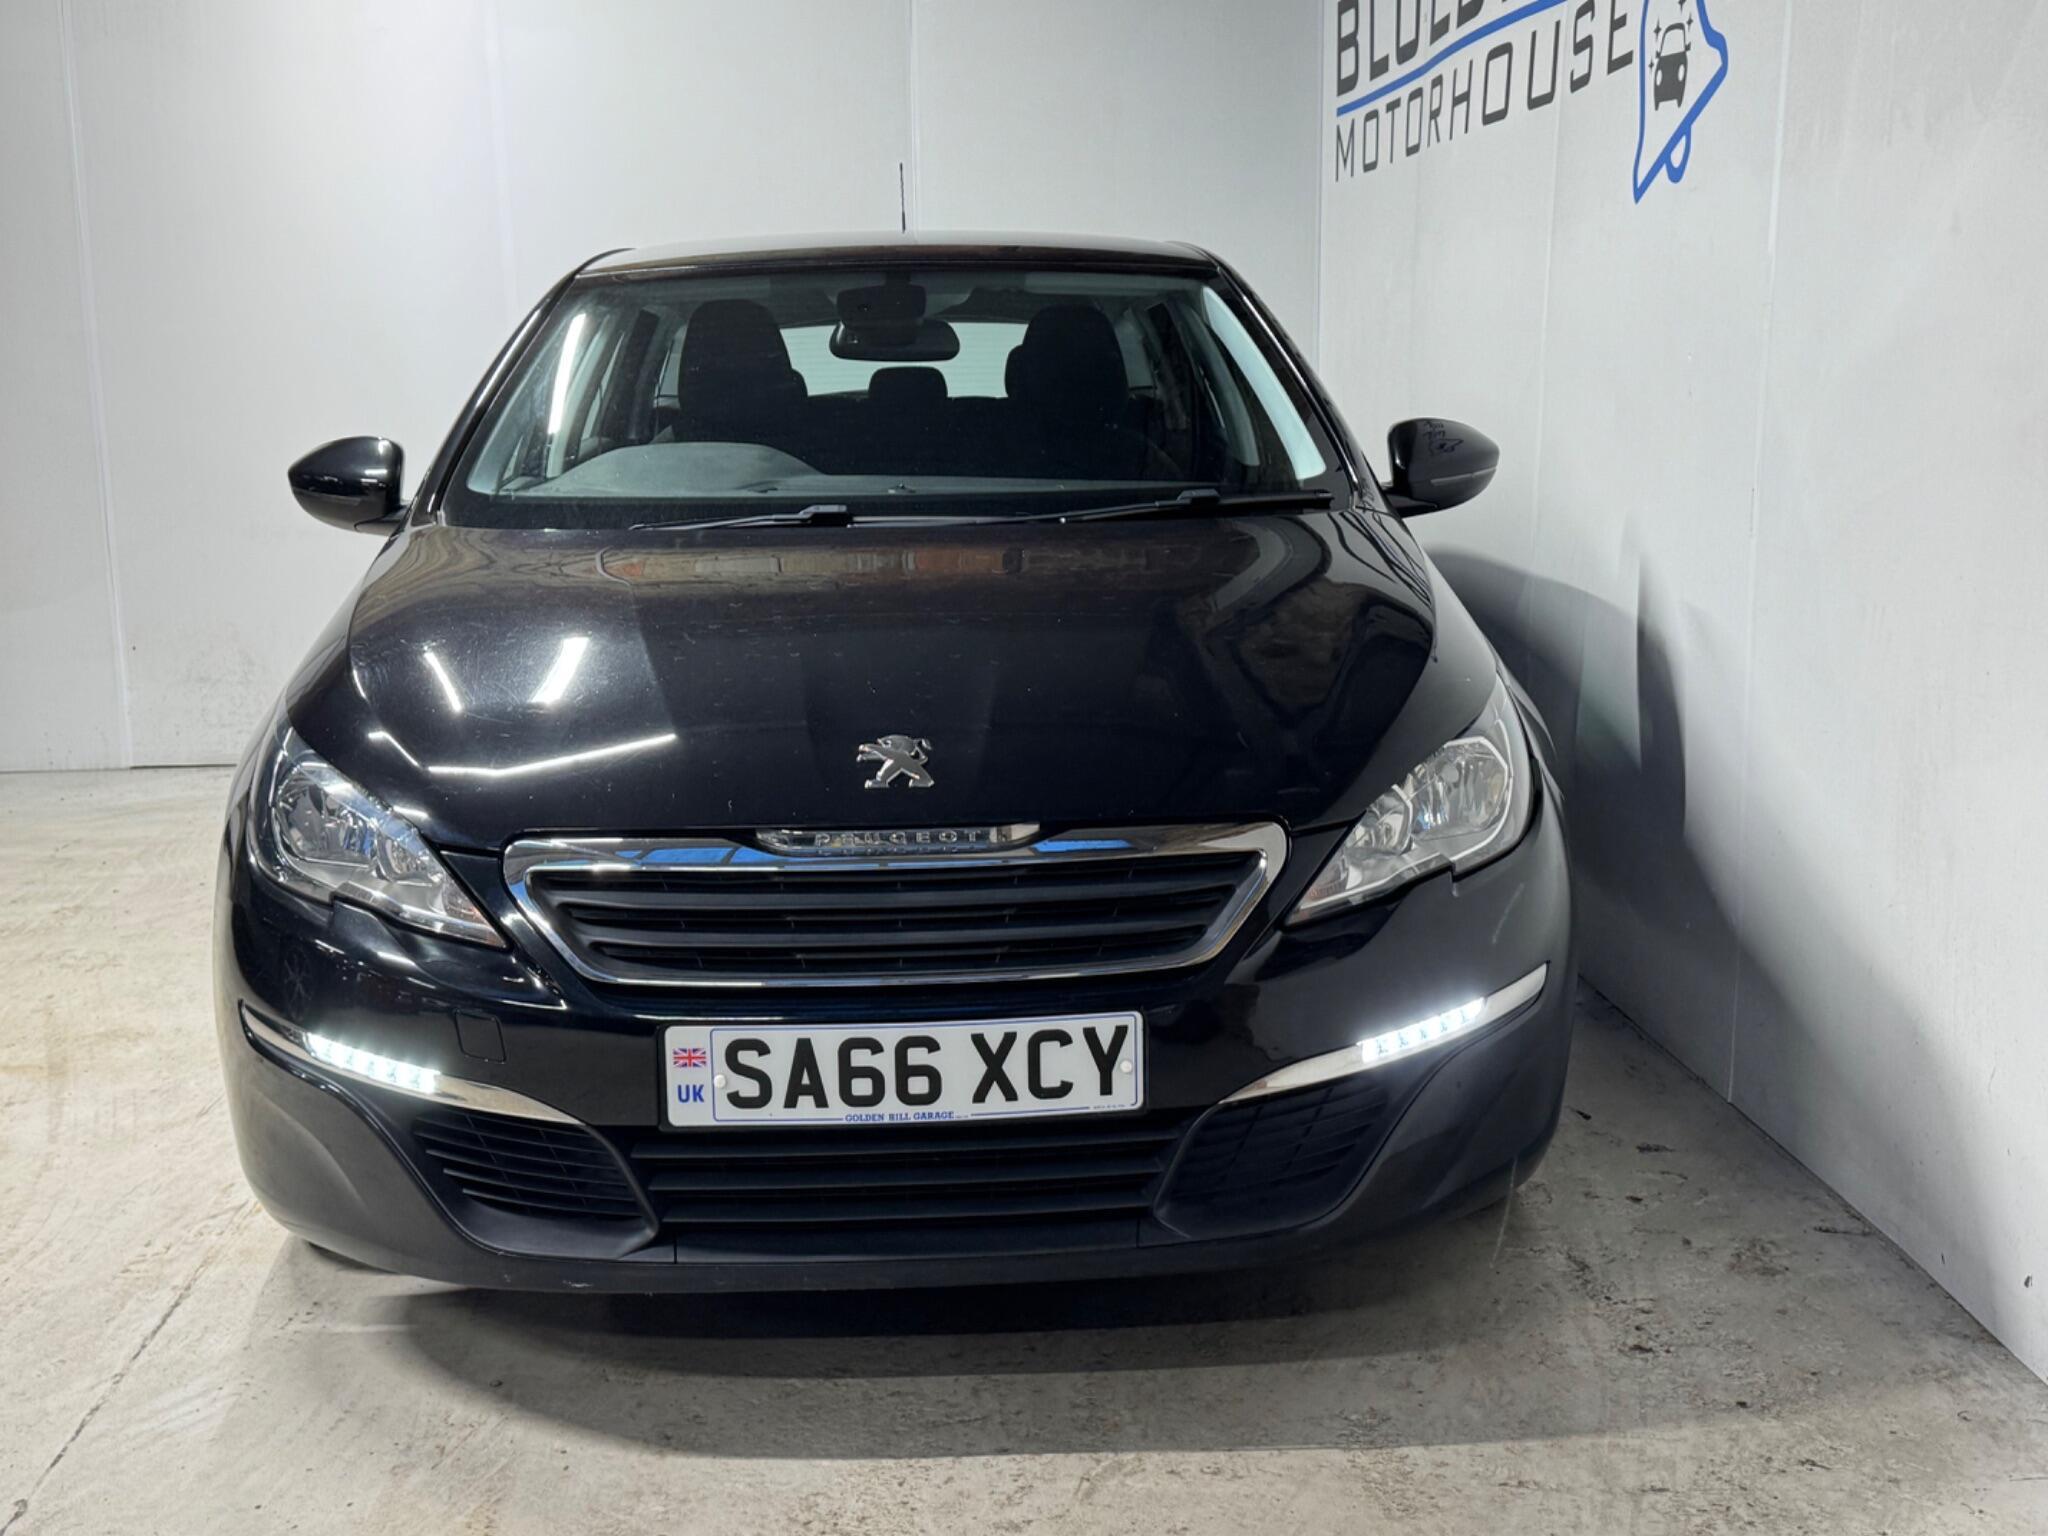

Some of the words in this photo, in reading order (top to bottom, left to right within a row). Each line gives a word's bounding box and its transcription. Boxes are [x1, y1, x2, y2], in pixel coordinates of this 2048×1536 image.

[1335, 0, 1634, 183] MOTORHOUSE
[677, 1084, 705, 1103] UK
[724, 1035, 943, 1110] SA66
[970, 1025, 1129, 1105] XCY
[845, 1112, 885, 1122] GOLDEN
[913, 1110, 955, 1121] GARAGE
